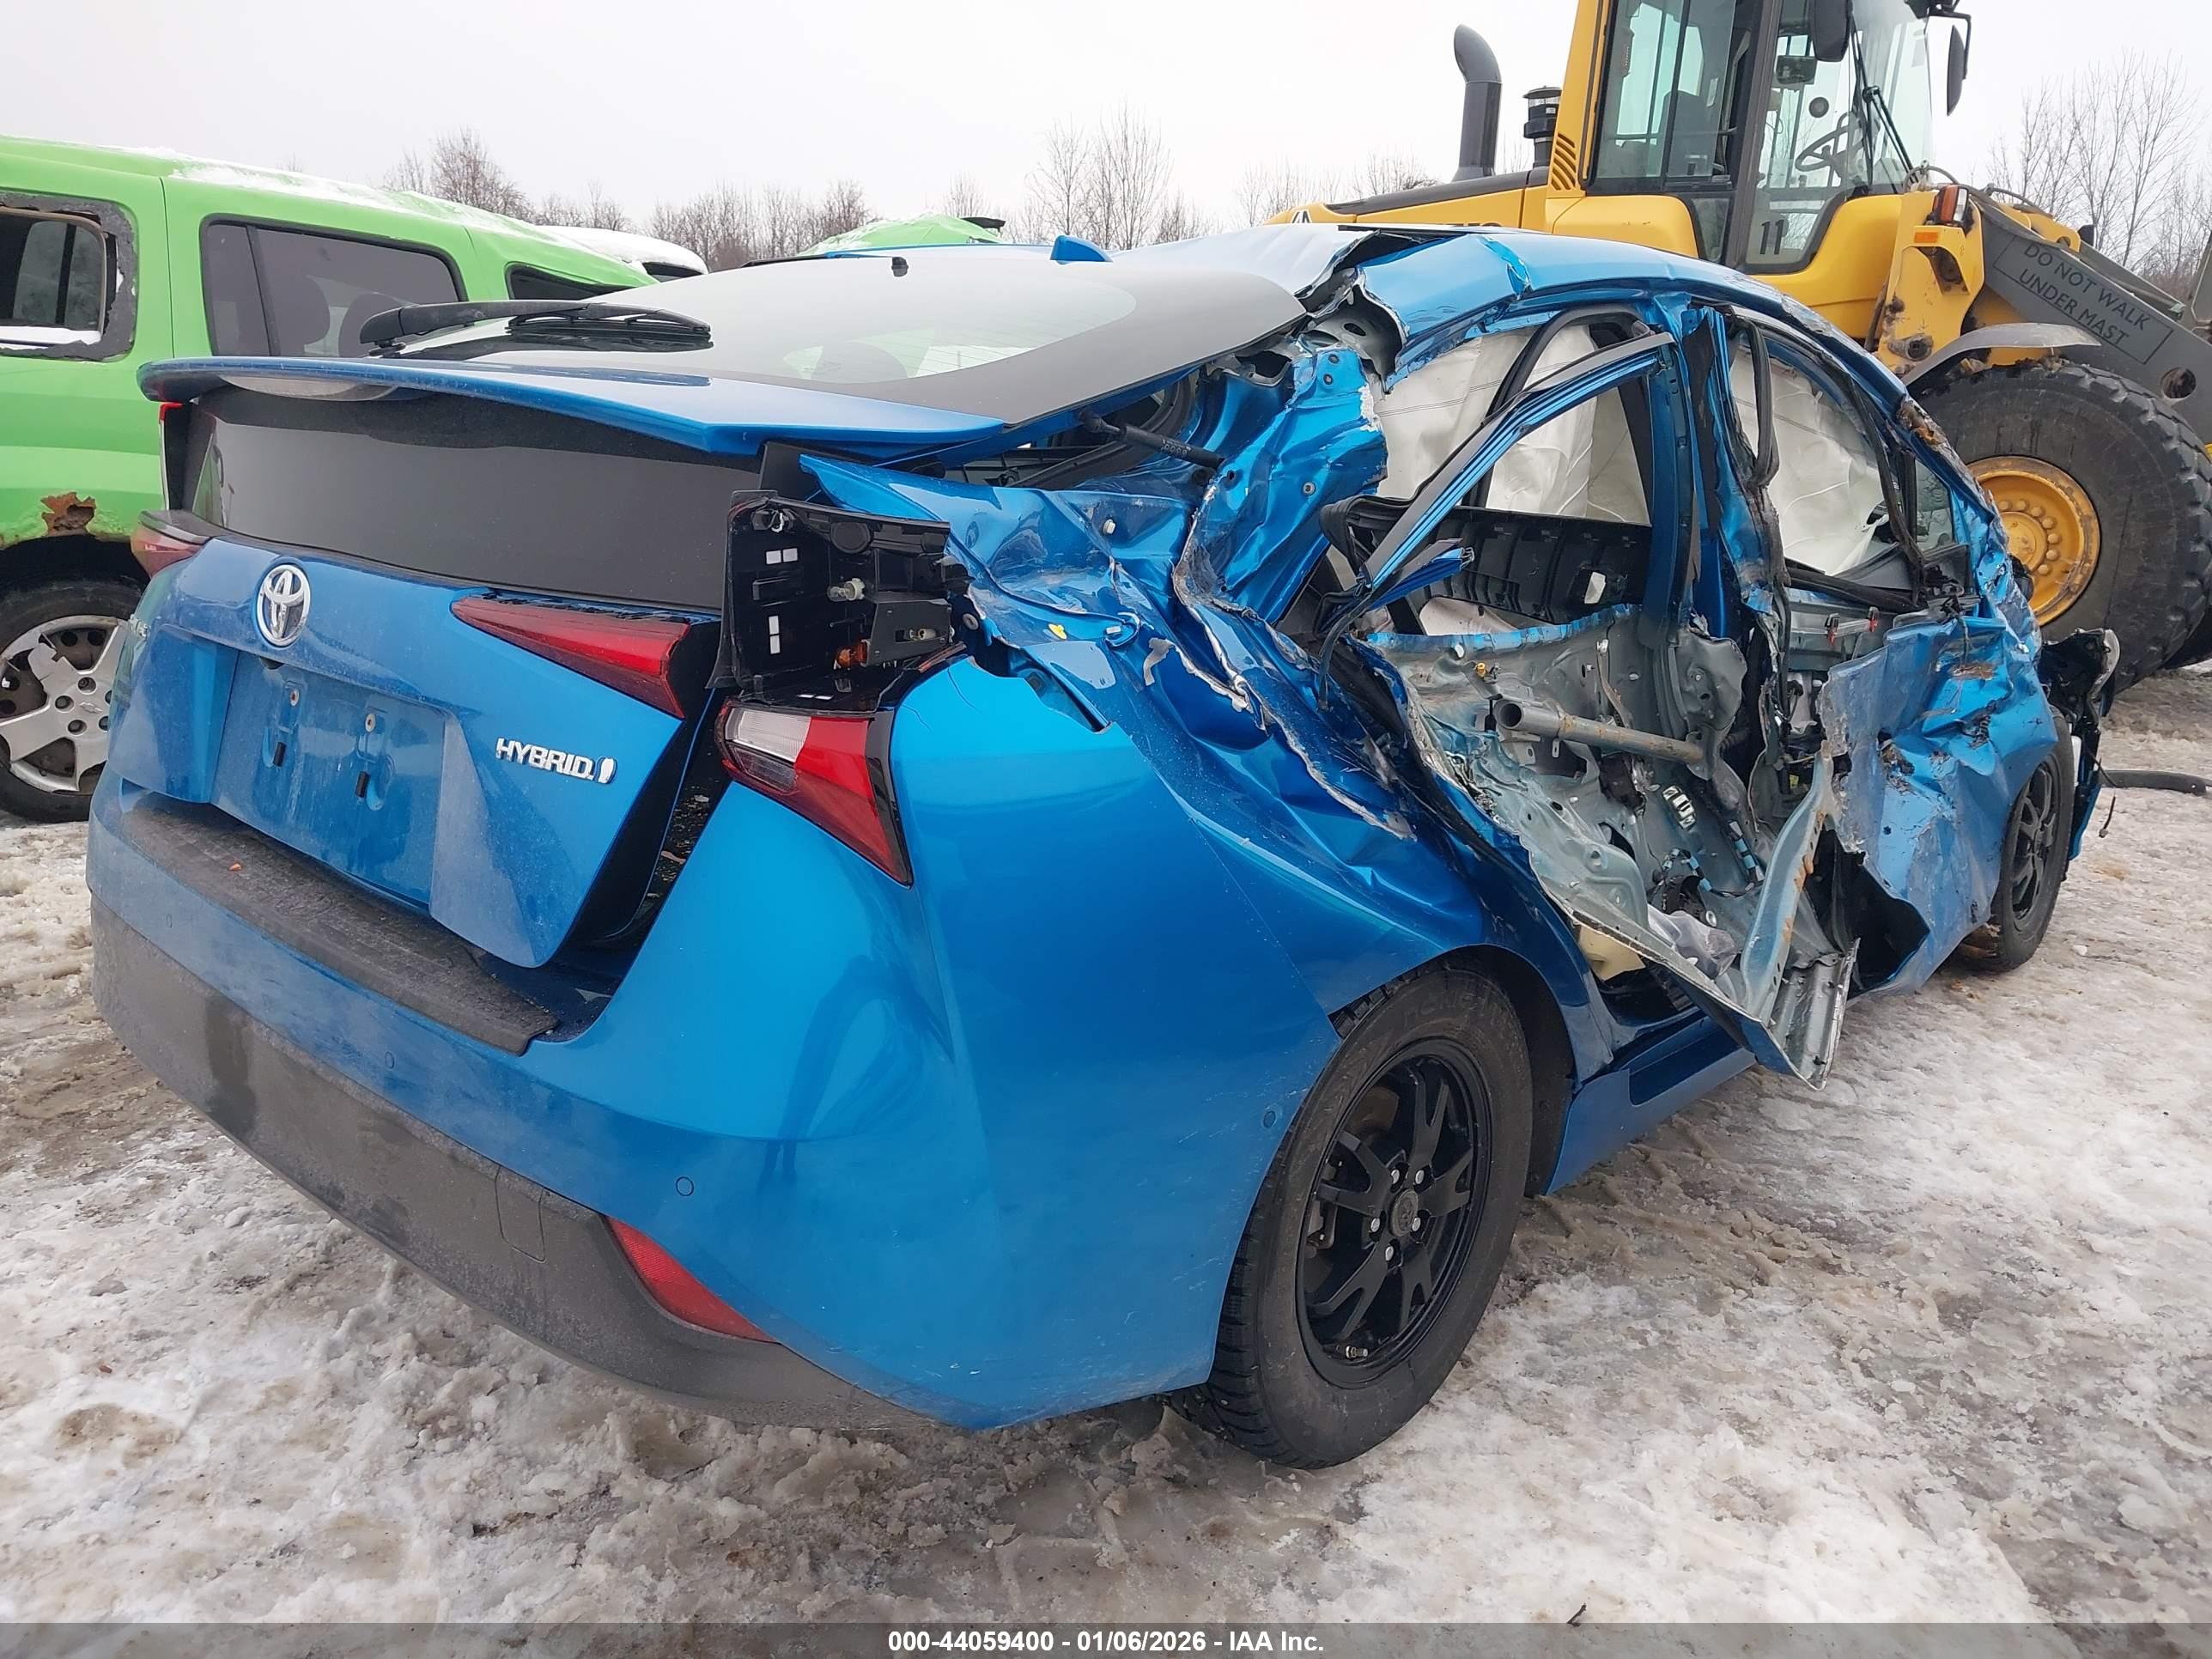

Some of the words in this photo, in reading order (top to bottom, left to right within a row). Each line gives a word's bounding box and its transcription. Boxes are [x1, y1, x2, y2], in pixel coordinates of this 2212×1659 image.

[1759, 219, 1784, 255] 11
[2019, 269, 2078, 315] UNDER
[2079, 308, 2130, 345] MAST
[2023, 242, 2053, 267] DO
[2054, 262, 2097, 294] NOT
[2098, 288, 2150, 331] WALK
[495, 737, 594, 781] HYBRID
